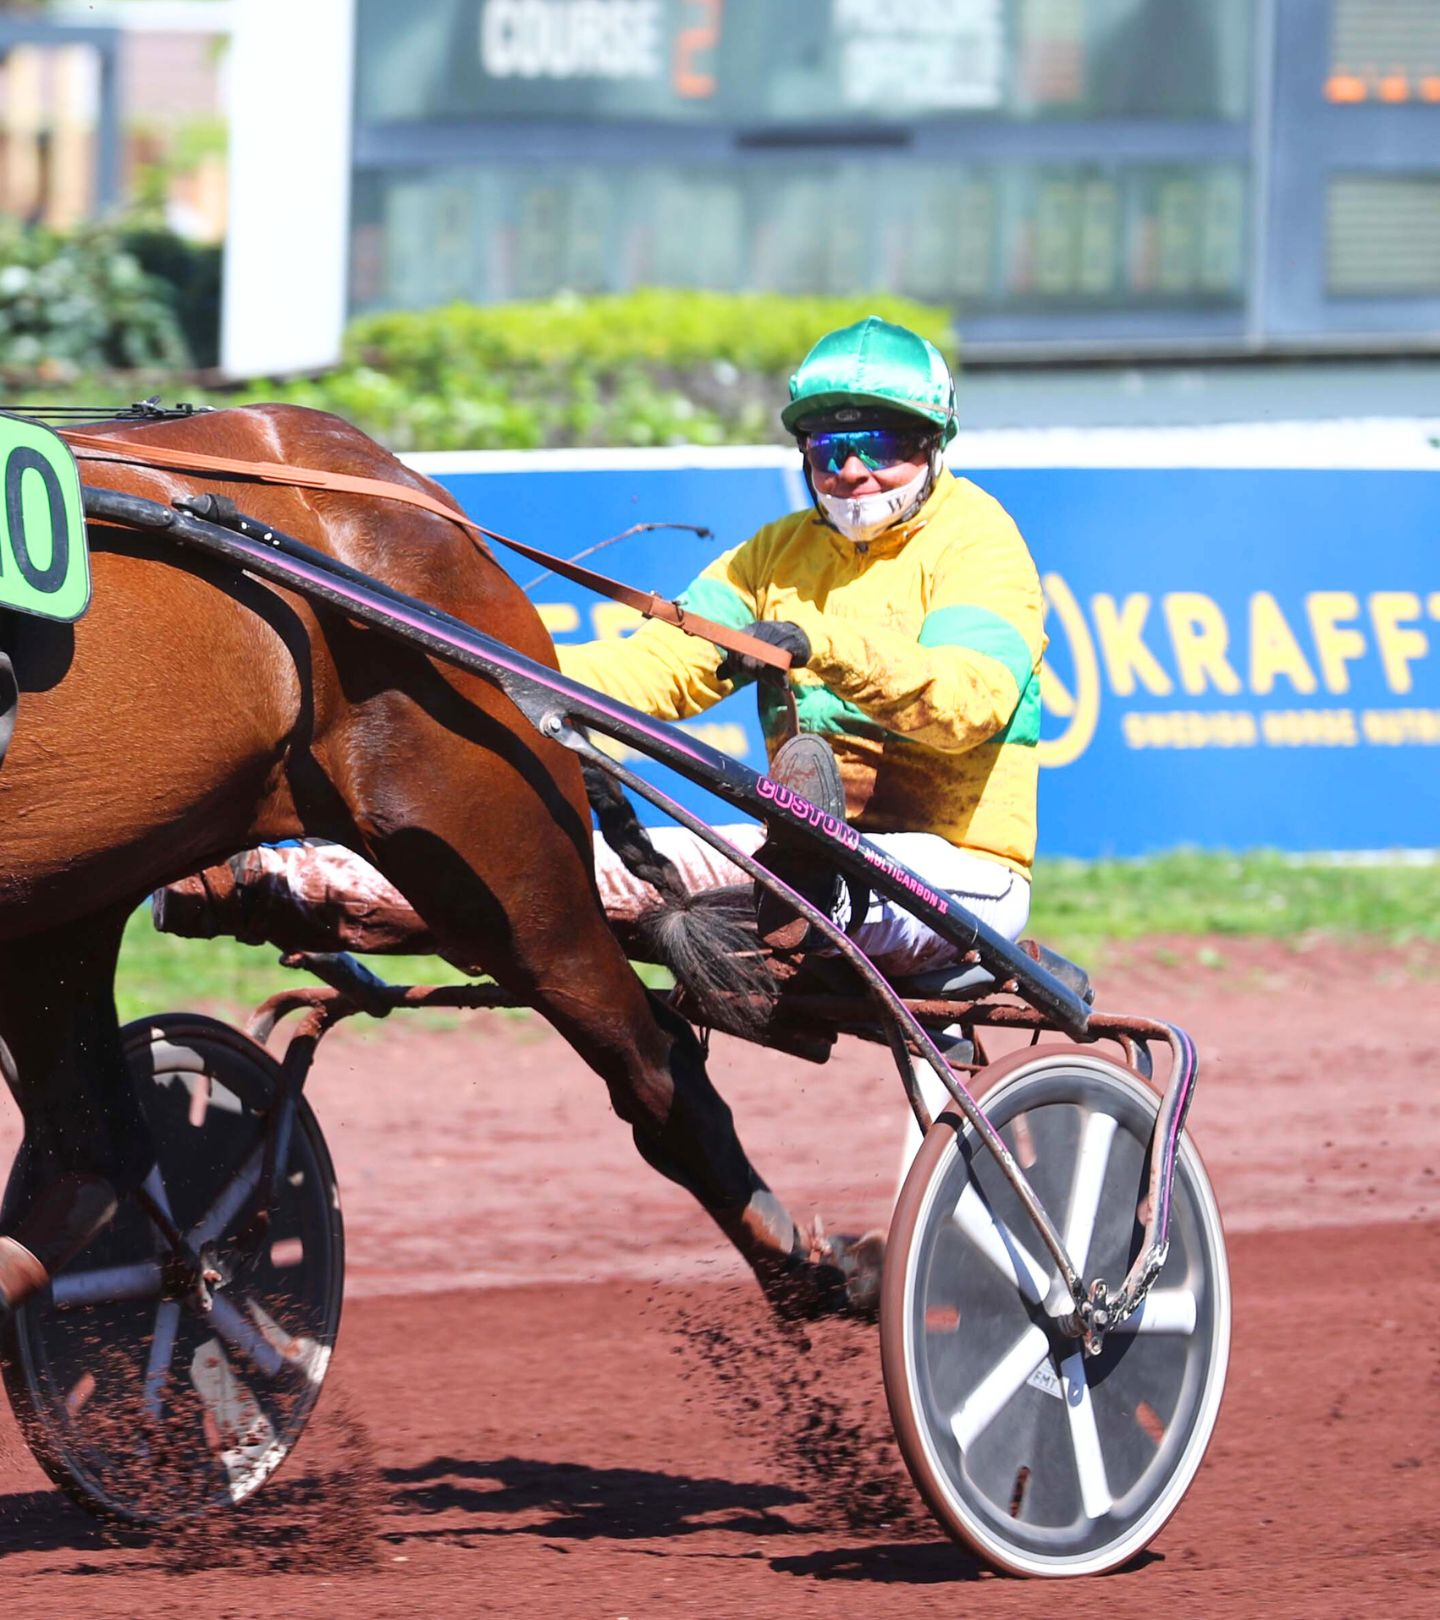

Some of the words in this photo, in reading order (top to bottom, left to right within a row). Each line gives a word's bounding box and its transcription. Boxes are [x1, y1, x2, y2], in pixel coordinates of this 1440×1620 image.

[671, 0, 723, 99] 2
[1090, 591, 1440, 697] KRAFF
[756, 776, 860, 850] CUSTOM
[863, 847, 939, 908] MULTICARBON
